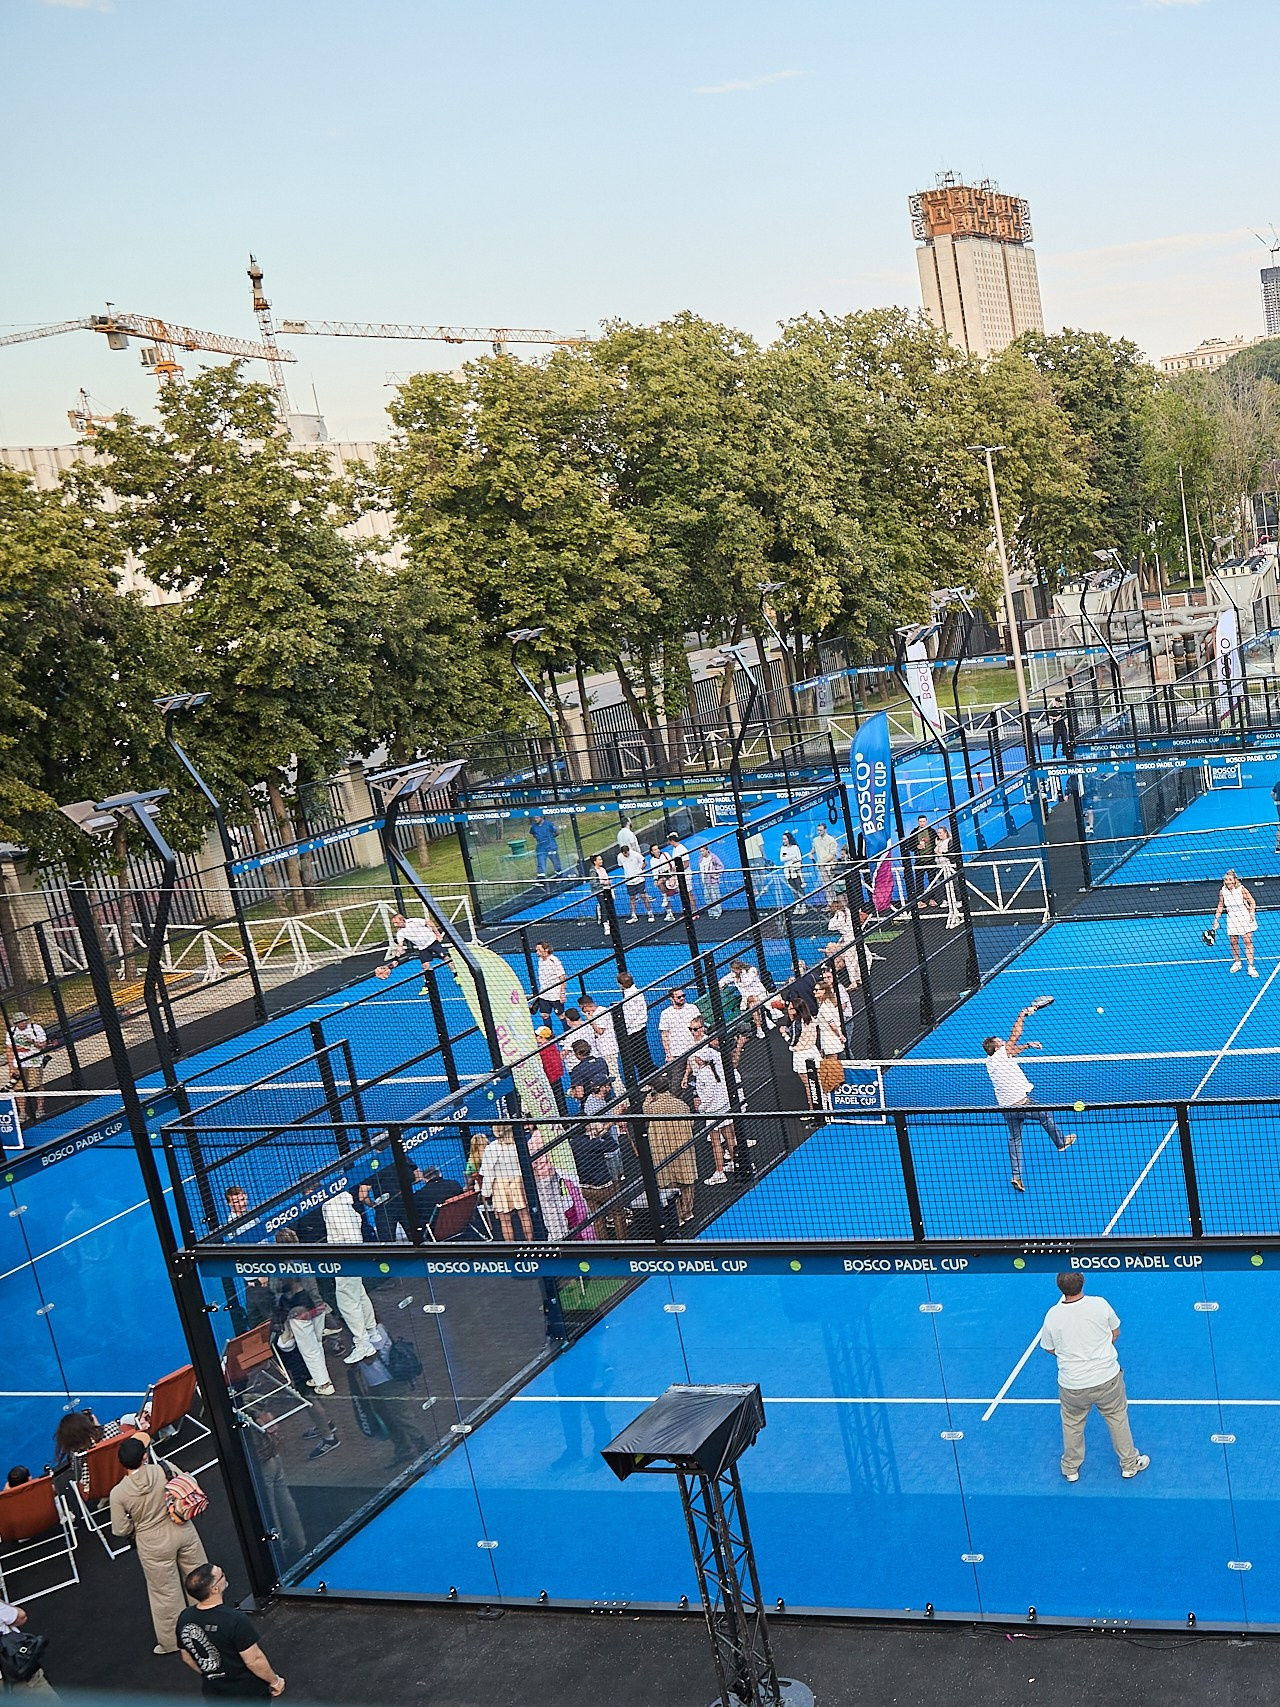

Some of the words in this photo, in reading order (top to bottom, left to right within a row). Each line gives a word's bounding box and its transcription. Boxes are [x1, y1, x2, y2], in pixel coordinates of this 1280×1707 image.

[876, 761, 886, 787] CUP
[856, 762, 875, 835] BOSCO
[876, 790, 886, 830] PADEL
[835, 1096, 859, 1105] PADEL
[861, 1097, 876, 1105] CUP
[453, 1107, 468, 1121] CUP
[42, 1144, 74, 1166] BOSCO
[76, 1131, 103, 1150] PADEL
[105, 1122, 122, 1136] CUP
[266, 1207, 299, 1232] BOSCO
[300, 1189, 329, 1212] PADEL
[330, 1178, 347, 1193] CUP
[236, 1263, 276, 1274] BOSCO
[279, 1262, 315, 1274] PADEL
[318, 1262, 341, 1273] CUP
[427, 1262, 469, 1273] BOSCO
[473, 1262, 511, 1273] PADEL
[514, 1261, 538, 1272] CUP
[630, 1260, 674, 1273] BOSCO
[679, 1260, 718, 1272] PADEL
[722, 1260, 748, 1272] CUP
[844, 1259, 891, 1271] BOSCO
[895, 1259, 937, 1271] PADEL
[942, 1258, 969, 1270] CUP
[1071, 1256, 1121, 1269] BOSCO
[1125, 1256, 1169, 1268] PADEL
[1174, 1256, 1202, 1268] CUP
